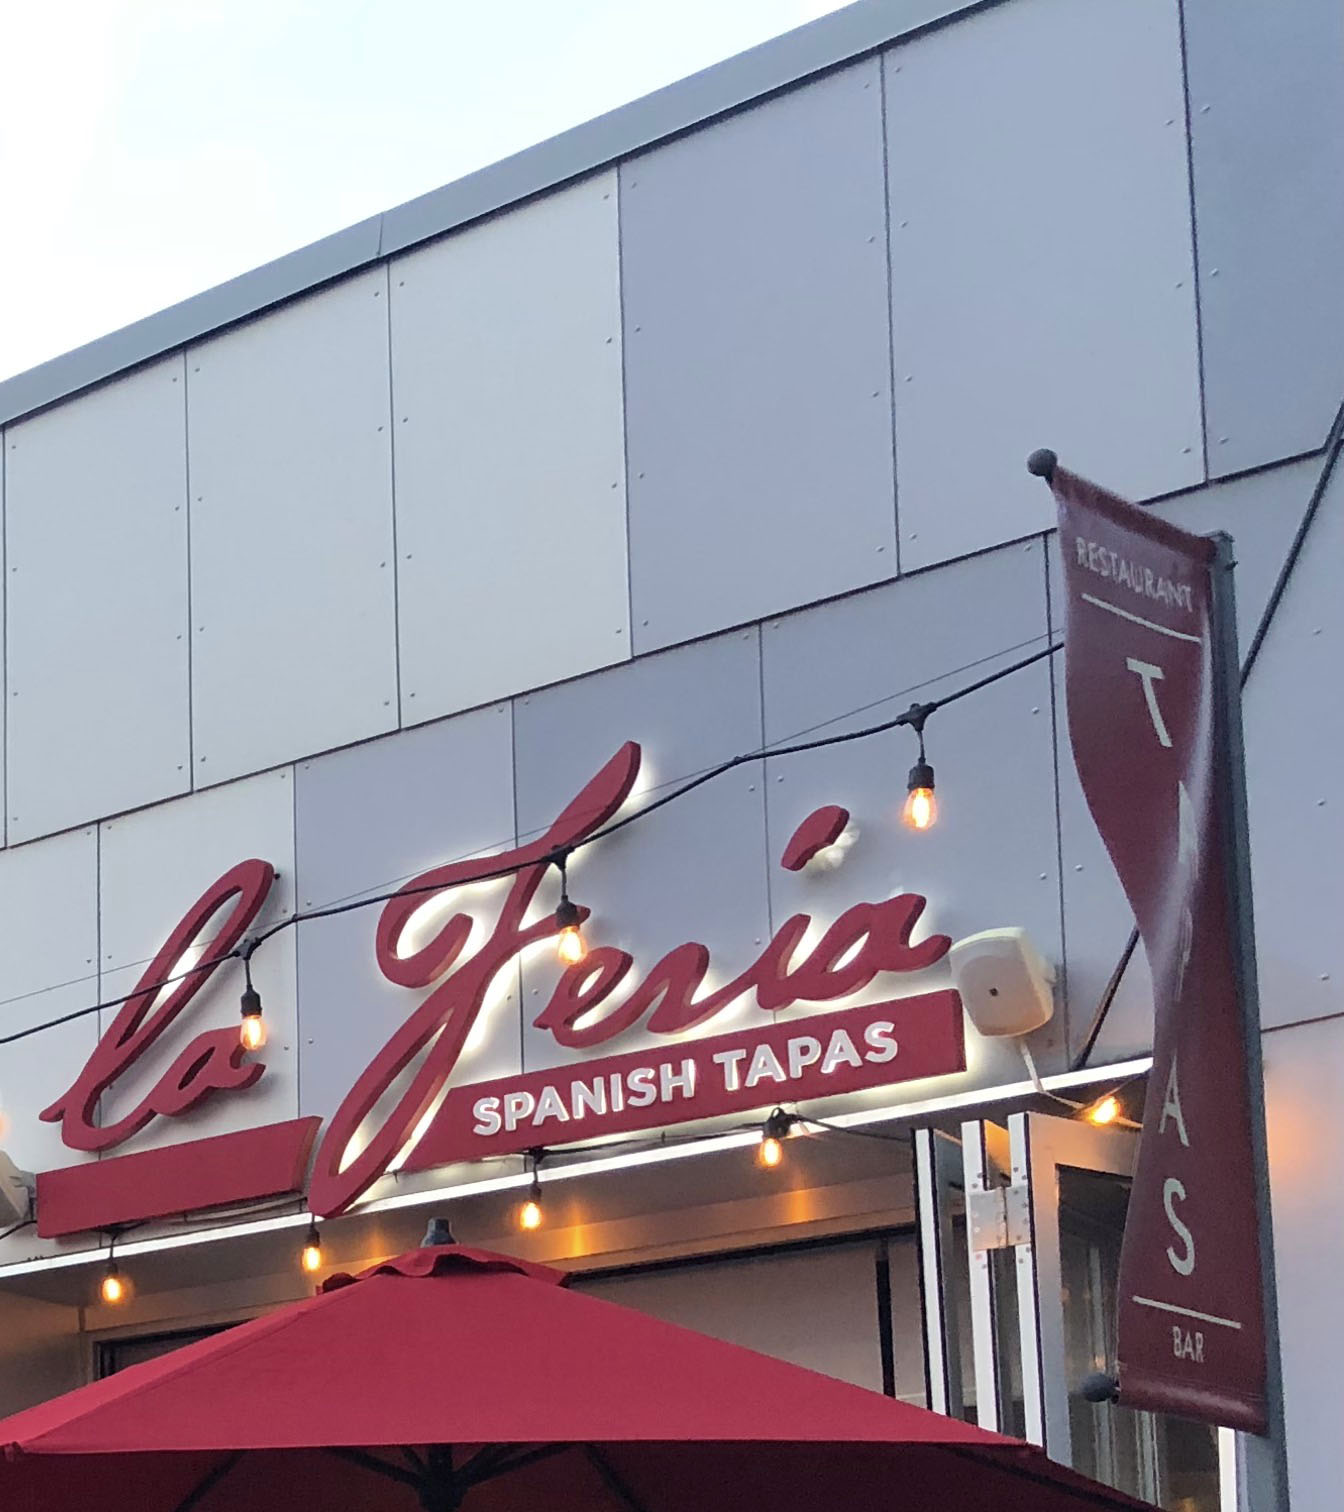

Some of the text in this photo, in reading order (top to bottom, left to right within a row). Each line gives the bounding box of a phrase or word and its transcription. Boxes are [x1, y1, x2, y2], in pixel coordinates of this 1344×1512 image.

[1075, 536, 1194, 613] RESTAURANT
[38, 739, 952, 1218] la Feria
[472, 1019, 899, 1138] SPANISH TAPAS
[1173, 1325, 1204, 1364] BAR
